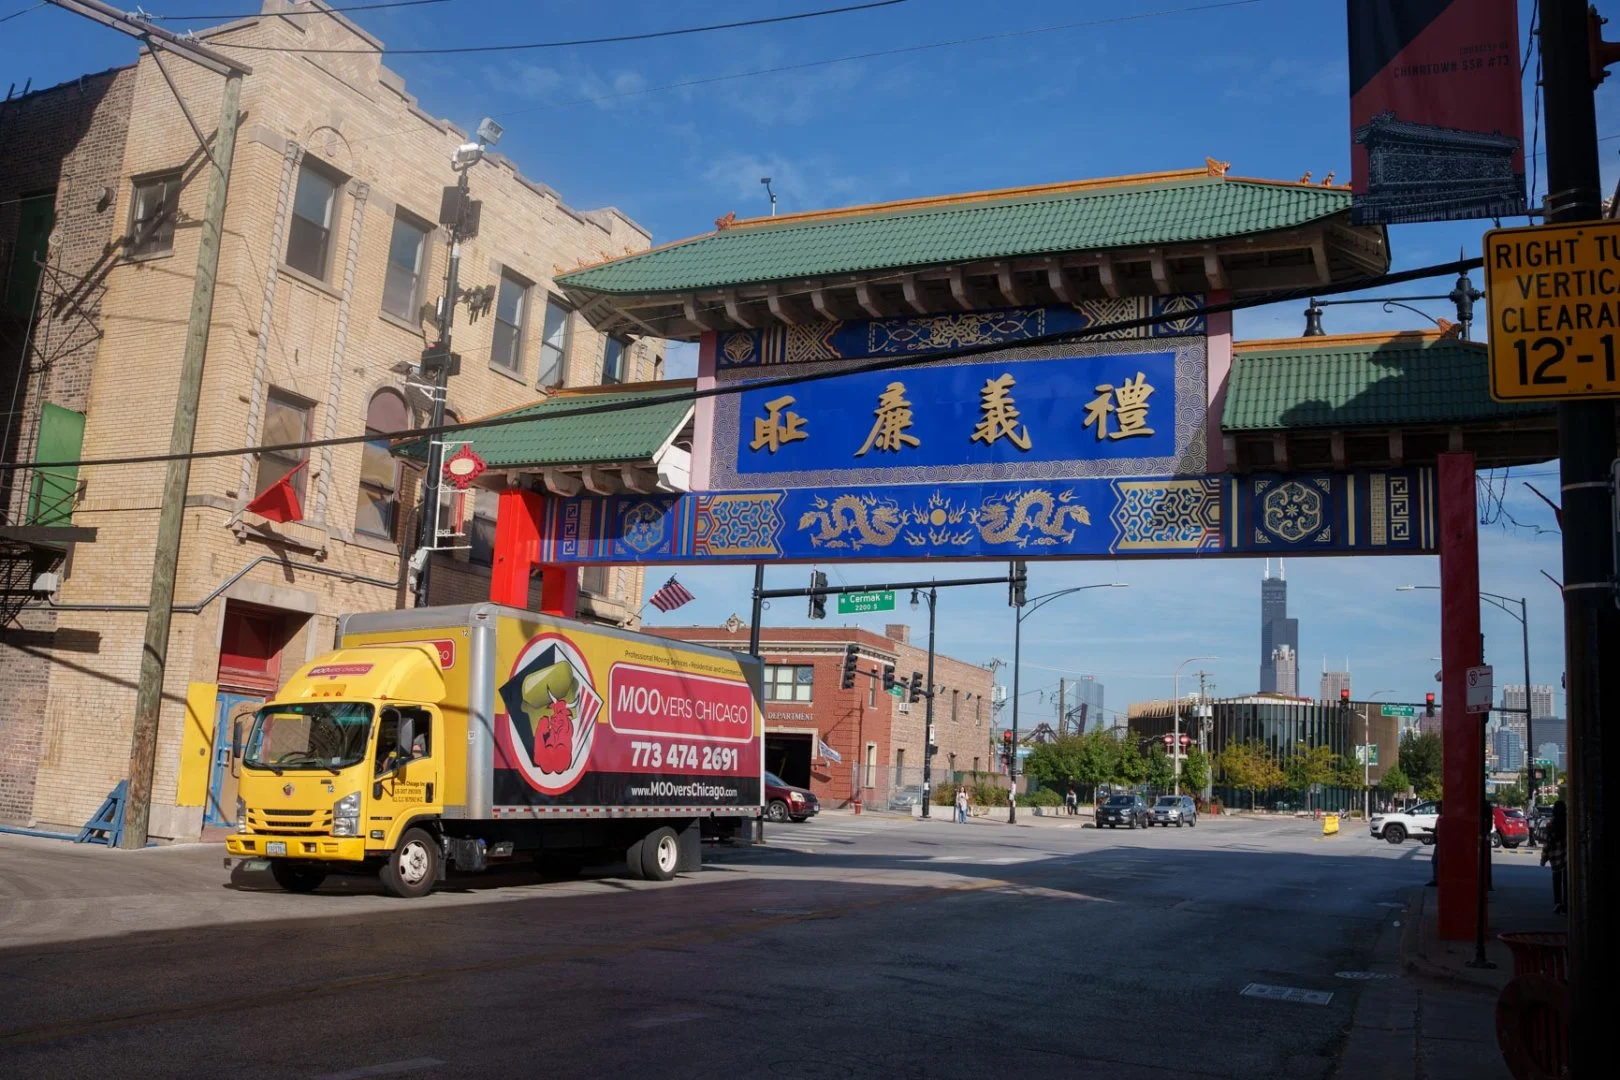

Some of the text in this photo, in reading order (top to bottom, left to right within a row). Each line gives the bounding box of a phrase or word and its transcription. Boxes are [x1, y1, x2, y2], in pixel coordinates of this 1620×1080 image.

[1394, 61, 1457, 78] CHINATOWN
[1488, 54, 1511, 69] #73
[1496, 239, 1579, 269] RIGHT
[1516, 268, 1620, 299] VERTIC
[1501, 301, 1620, 333] CLEARA
[850, 593, 881, 603] Cermak
[462, 629, 468, 637] 12
[618, 685, 748, 724] MOOVERS CHICAGO
[768, 711, 815, 720] DEPARTMENT
[631, 741, 738, 771] 773 474 2691
[327, 785, 334, 793] 12
[631, 781, 738, 800] www.MOOversChicago.com
